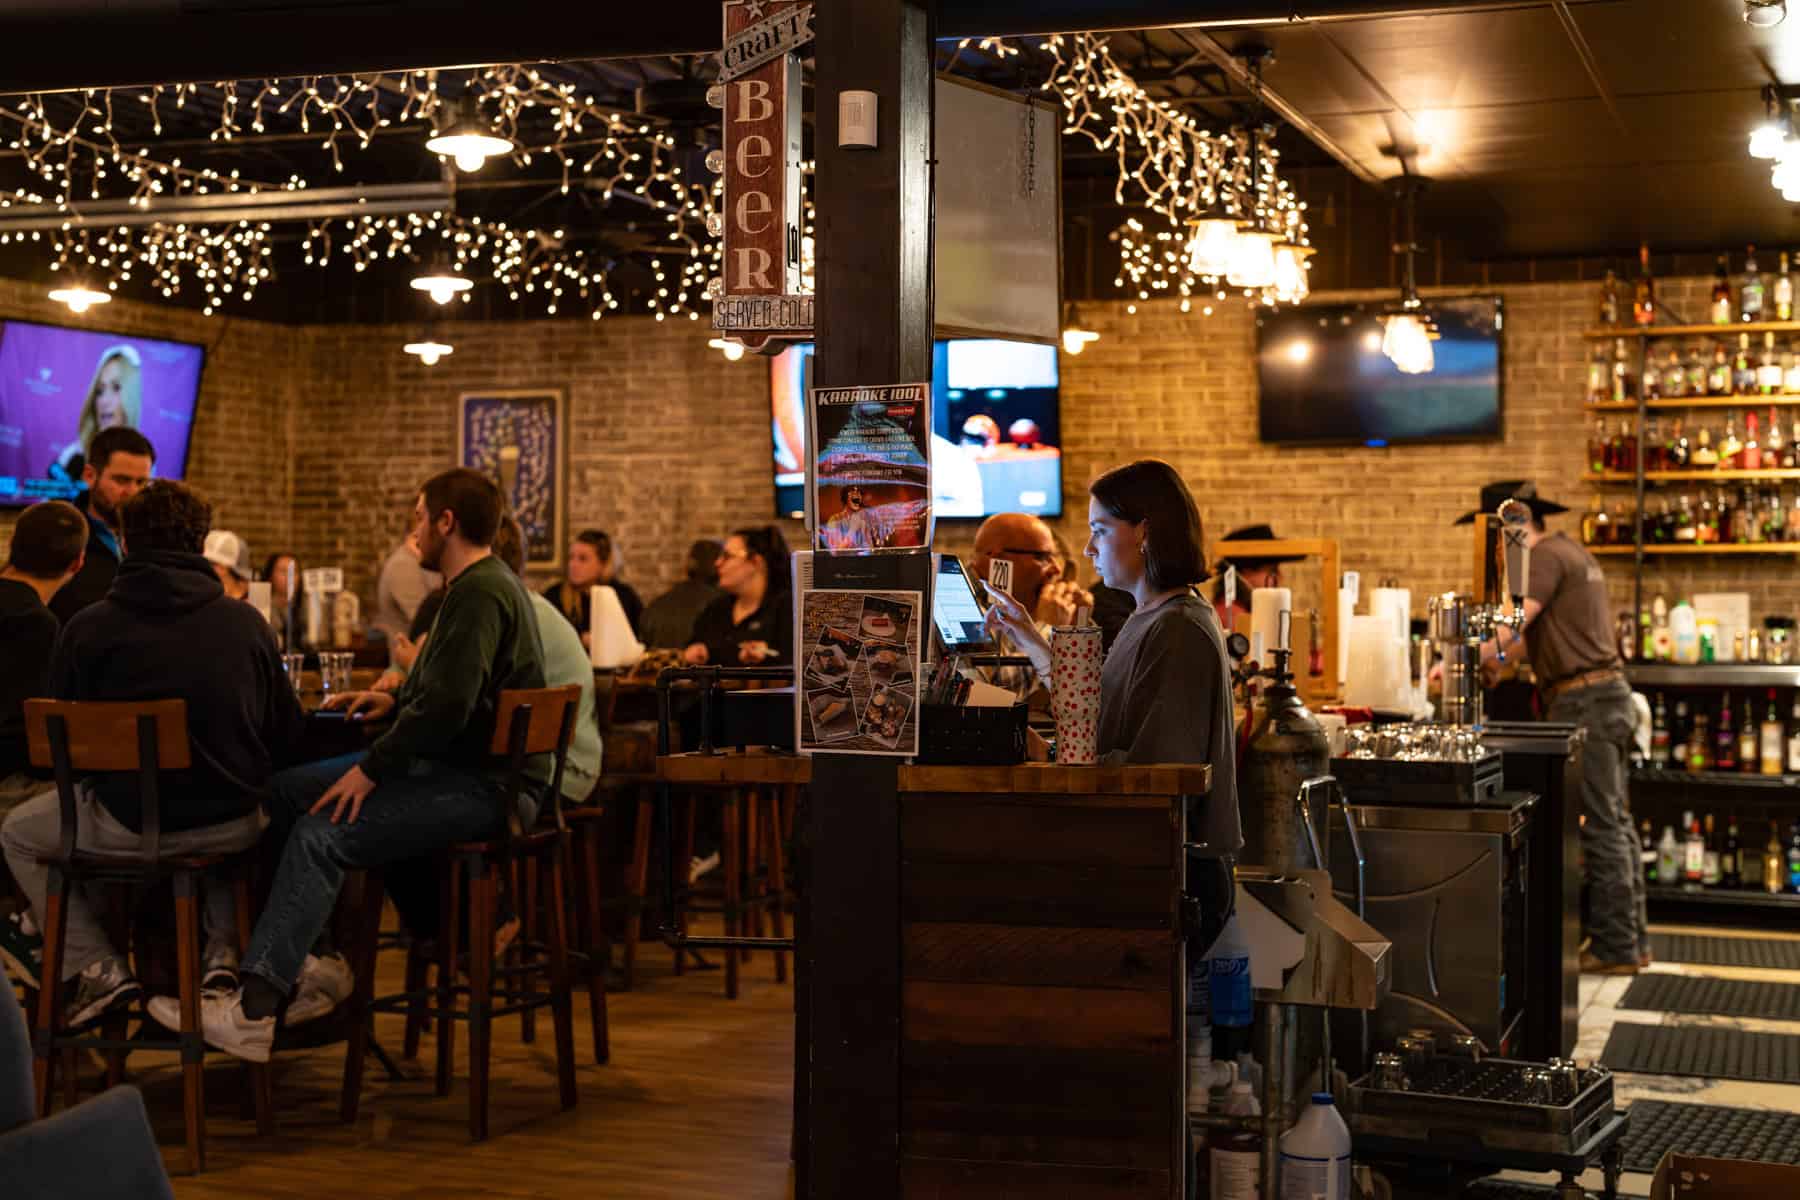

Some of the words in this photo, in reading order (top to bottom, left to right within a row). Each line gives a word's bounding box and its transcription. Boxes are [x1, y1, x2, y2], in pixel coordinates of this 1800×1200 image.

[818, 389, 888, 405] KARAOKE
[890, 387, 922, 401] IDOL
[993, 560, 1008, 590] 220
